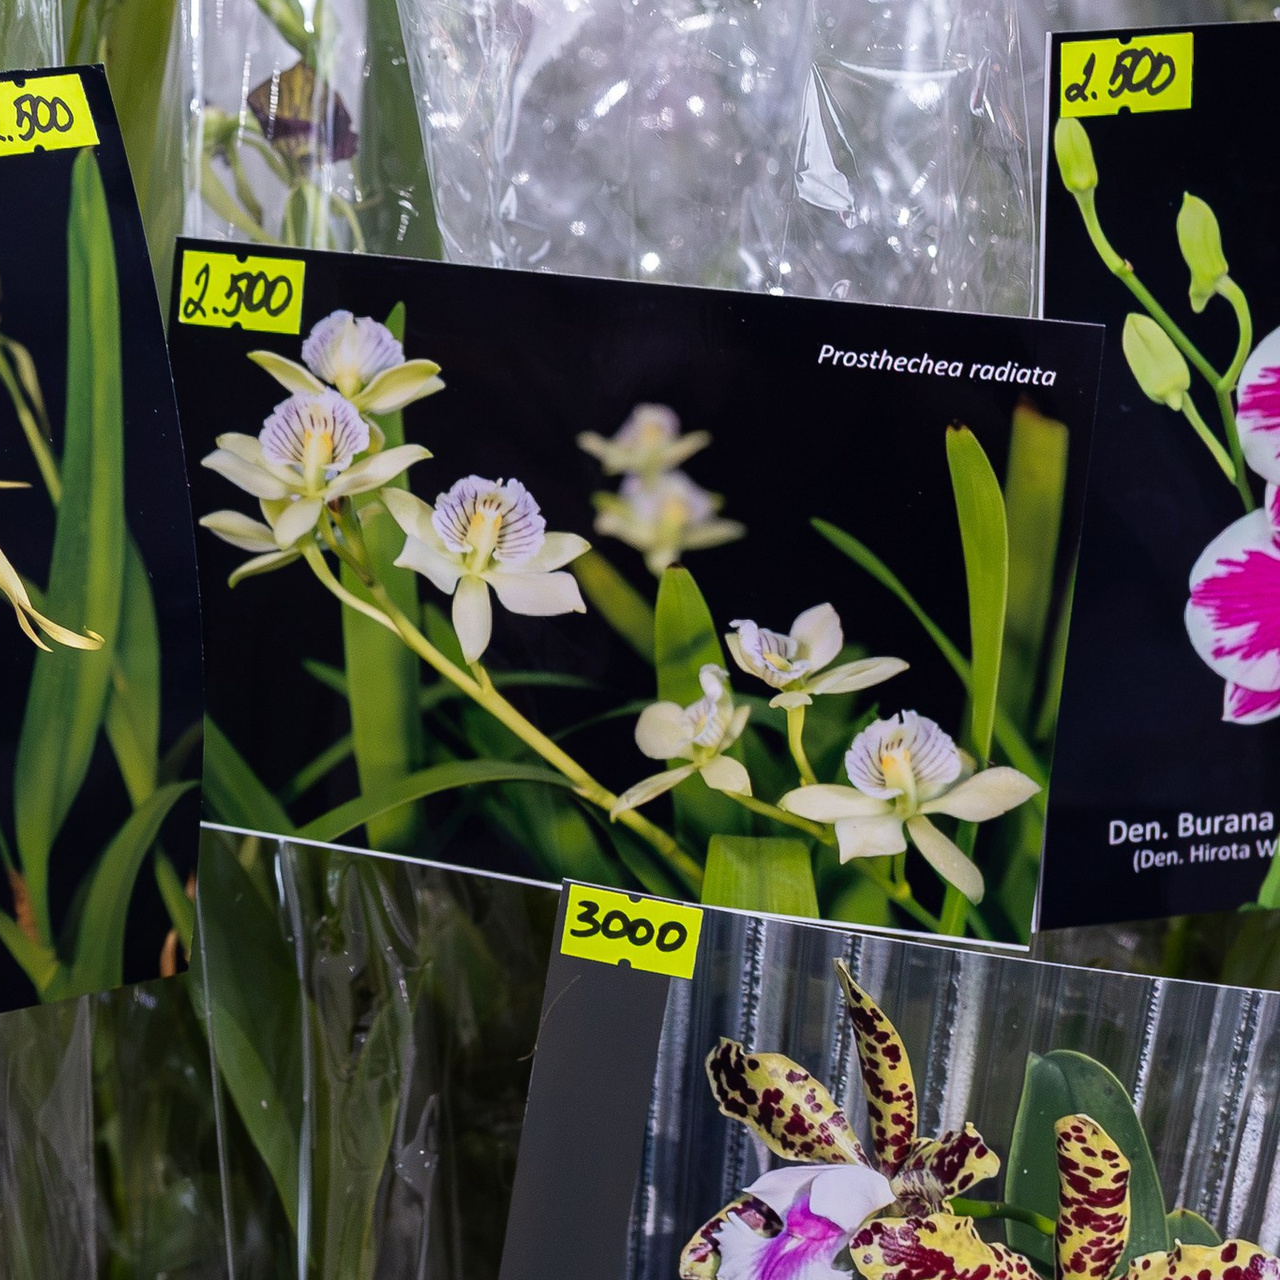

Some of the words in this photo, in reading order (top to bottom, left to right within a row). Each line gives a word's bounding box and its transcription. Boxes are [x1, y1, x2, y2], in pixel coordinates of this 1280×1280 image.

[1065, 47, 1176, 103] 2.500
[183, 263, 293, 319] 2.500
[817, 344, 963, 377] Prosthechea
[969, 361, 1057, 386] radiata
[1109, 820, 1169, 846] Den.
[1178, 811, 1274, 838] Burana
[1133, 849, 1184, 874] (Den.
[1189, 842, 1251, 864] Hirota
[1256, 837, 1280, 859] W
[570, 900, 687, 953] 3000
